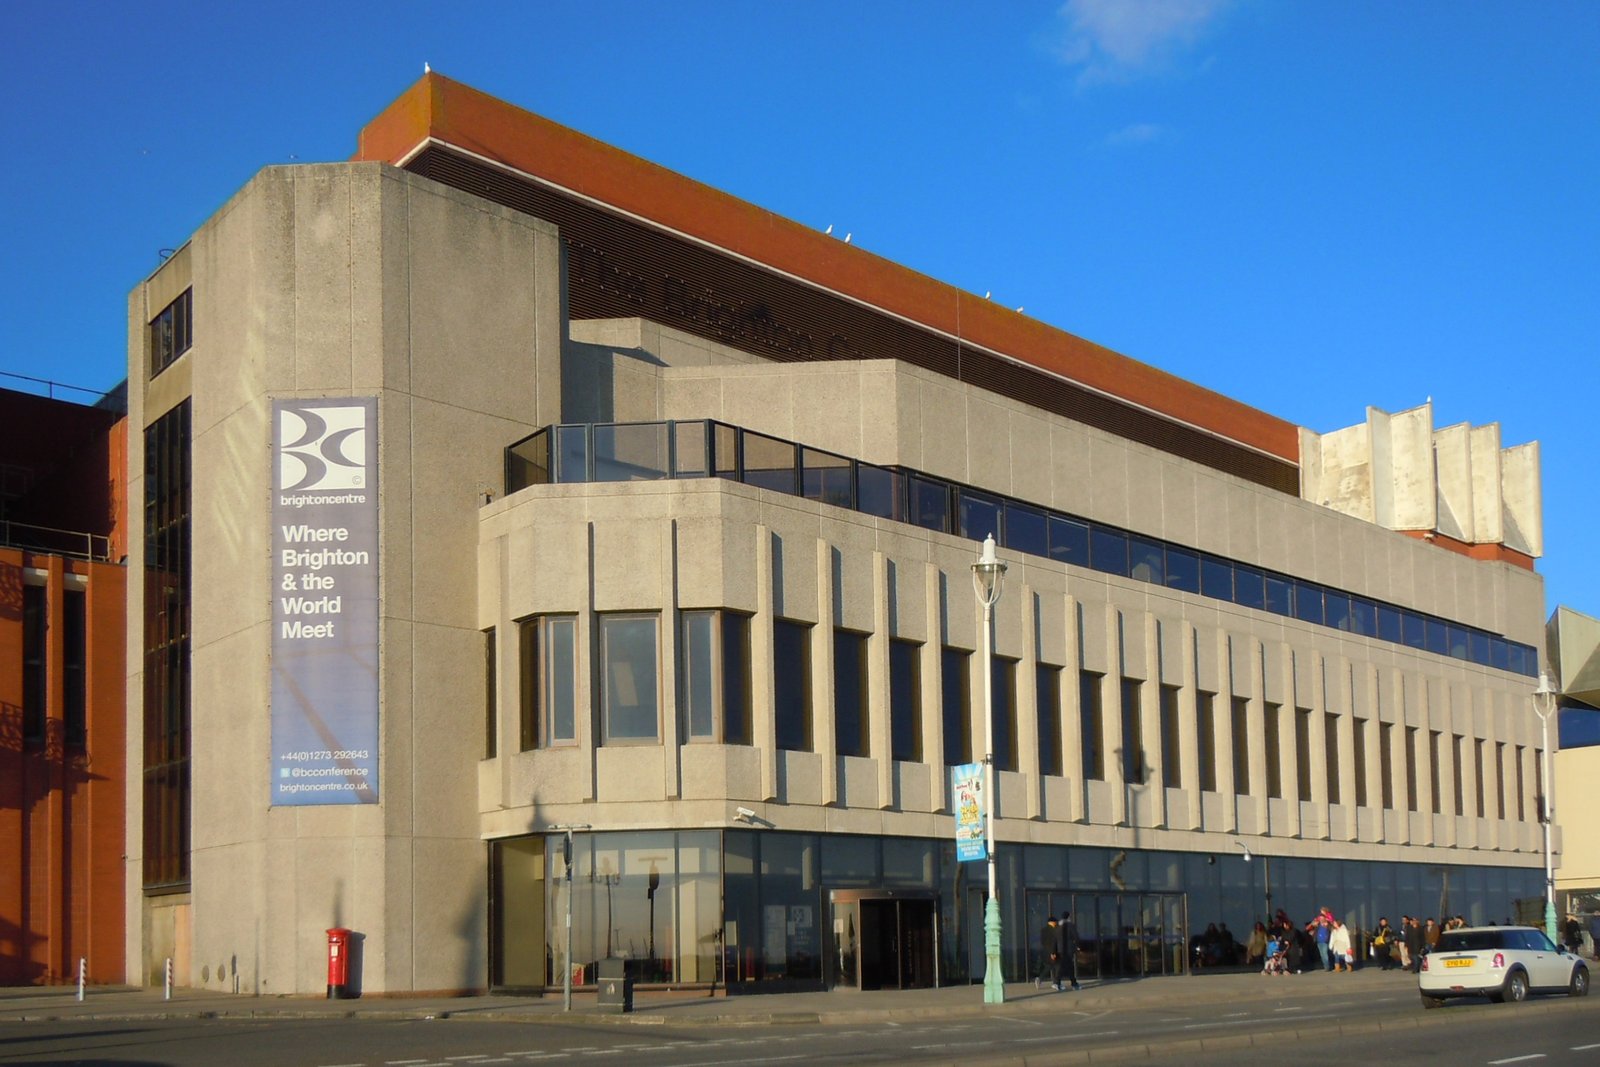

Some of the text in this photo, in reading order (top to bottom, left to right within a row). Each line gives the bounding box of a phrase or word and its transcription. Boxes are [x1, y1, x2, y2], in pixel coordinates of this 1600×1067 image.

[281, 494, 366, 508] brightoncentre
[282, 525, 349, 543] Where
[282, 548, 369, 570] Brighton
[281, 573, 335, 591] & the
[281, 596, 341, 615] World
[282, 621, 335, 639] Meet
[280, 751, 331, 761] +44(0)1273
[292, 767, 369, 777] @bcconference
[280, 782, 368, 793] brightoncentre.co.uk
